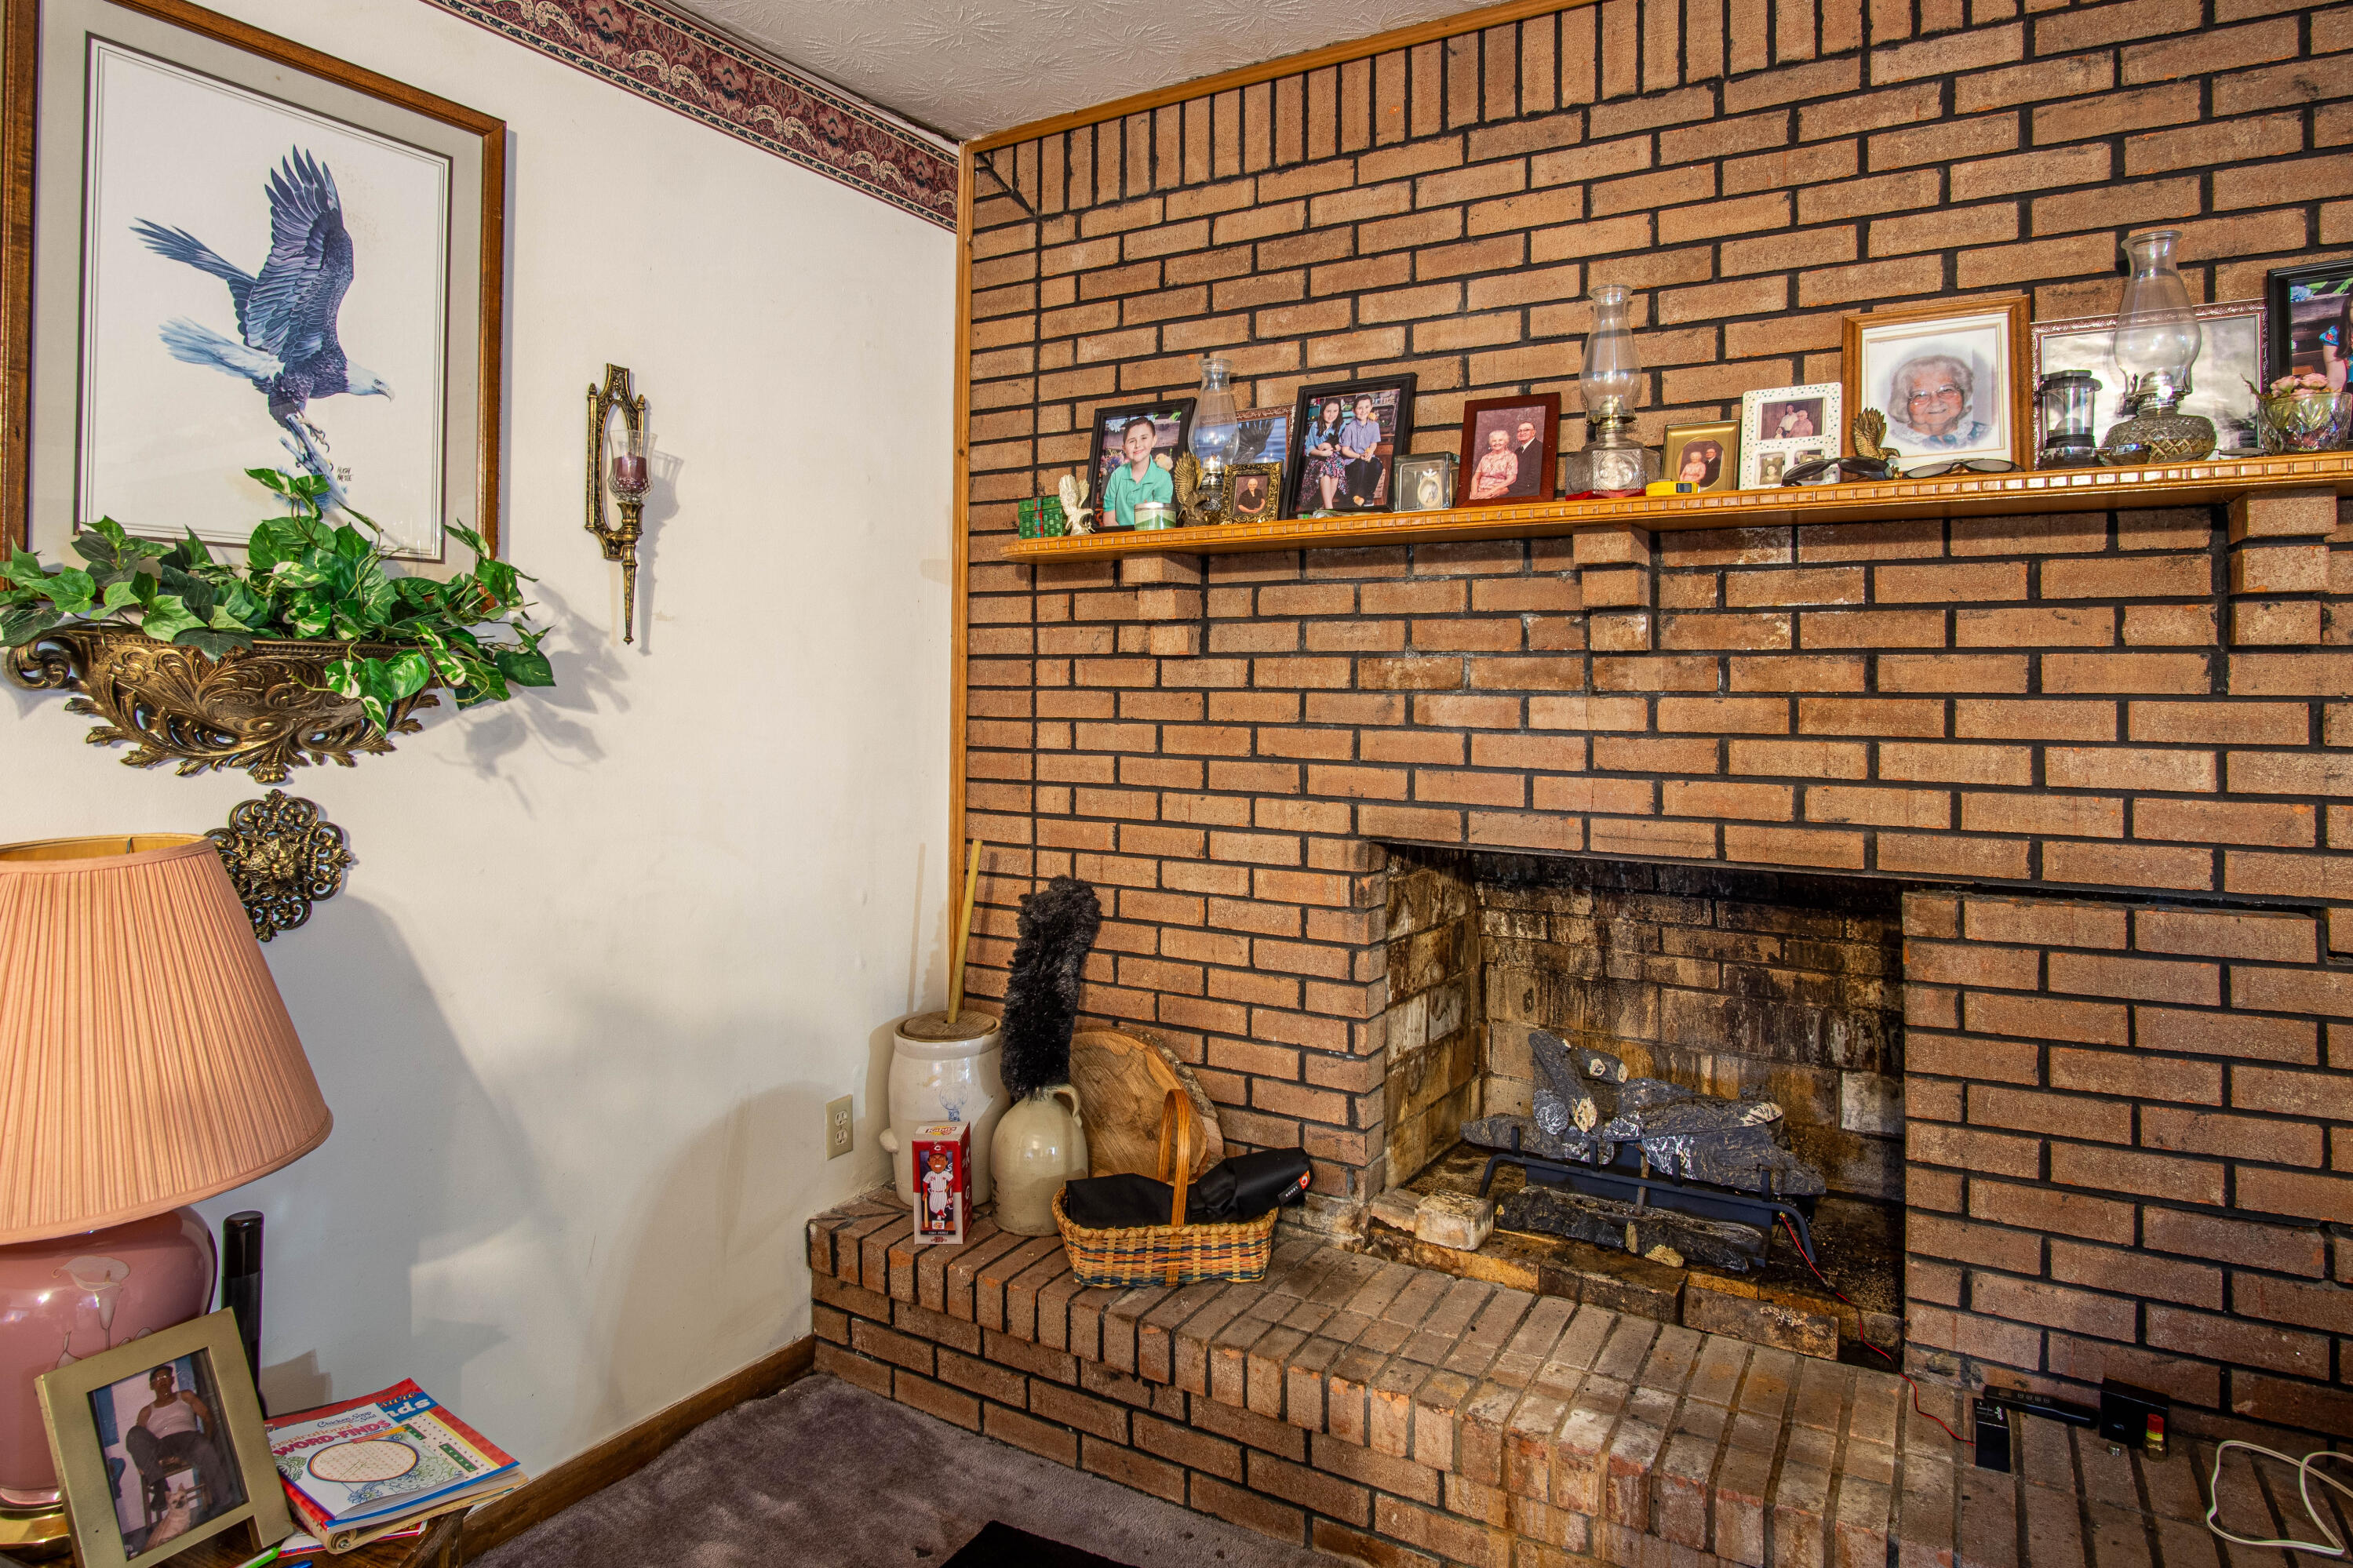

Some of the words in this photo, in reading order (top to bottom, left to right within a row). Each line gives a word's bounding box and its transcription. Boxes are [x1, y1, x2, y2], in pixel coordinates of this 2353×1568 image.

[317, 1417, 351, 1428] Chicken
[271, 1423, 353, 1449] nspirational
[272, 1419, 392, 1456] WORD-FINDS
